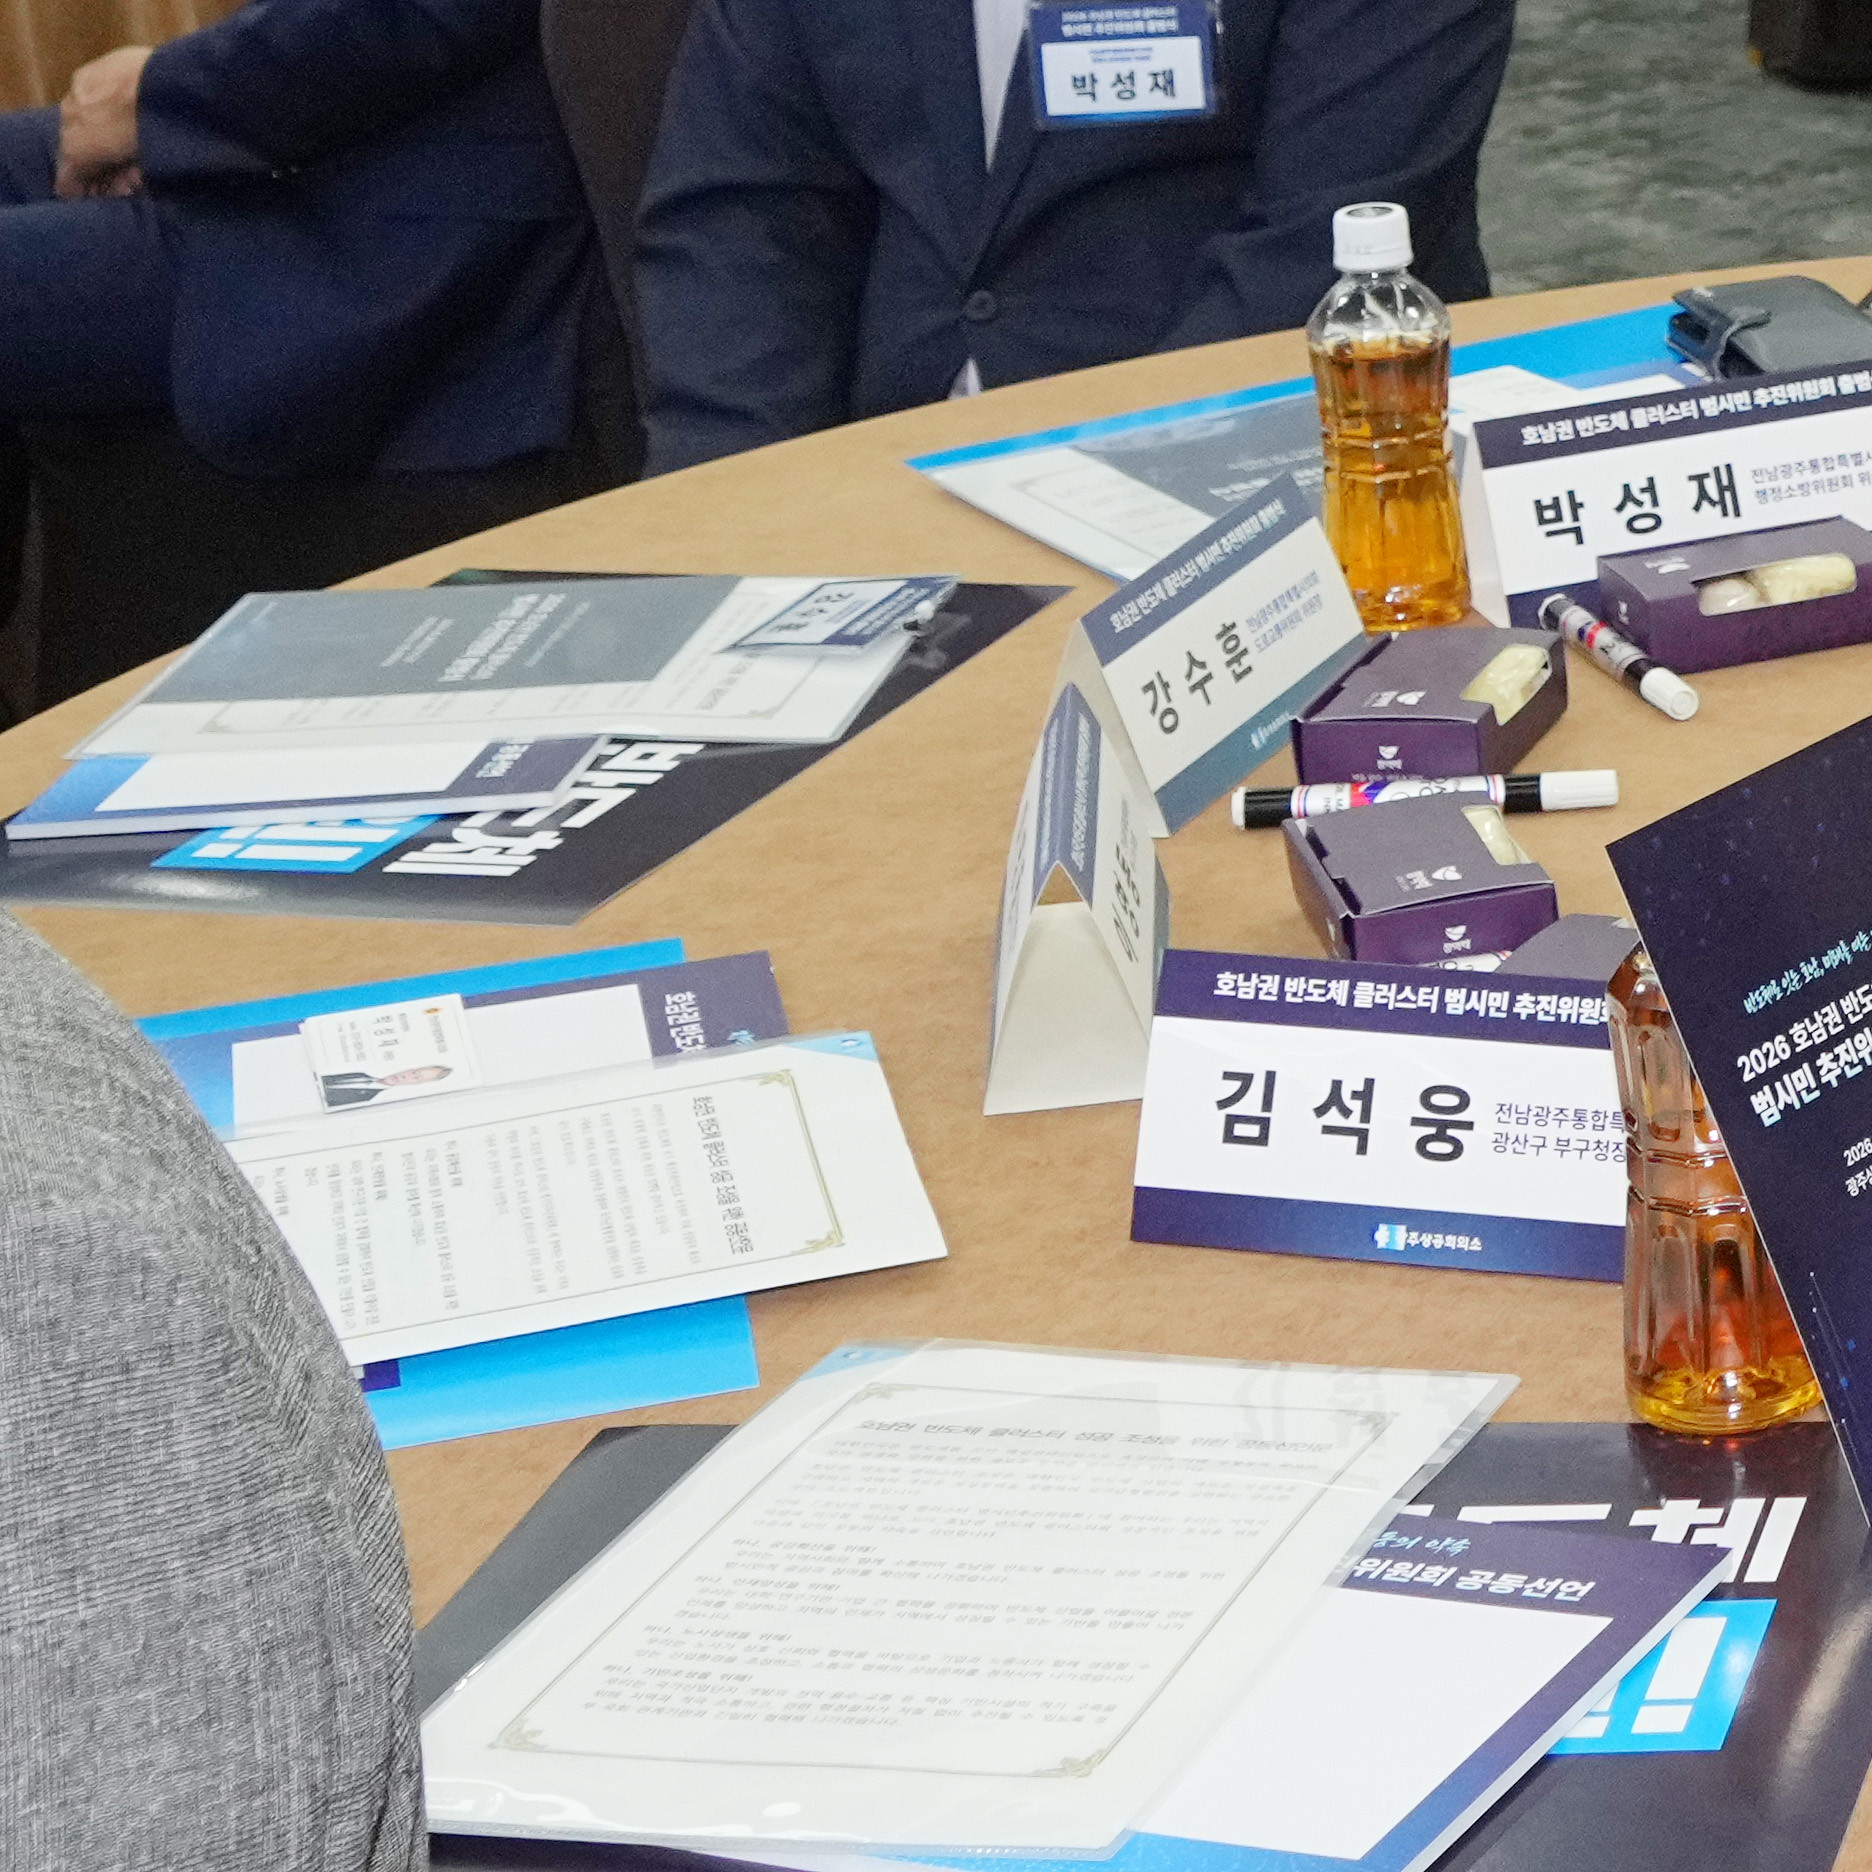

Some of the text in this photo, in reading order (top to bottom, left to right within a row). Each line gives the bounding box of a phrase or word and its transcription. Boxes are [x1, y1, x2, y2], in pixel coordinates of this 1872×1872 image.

[1072, 68, 1176, 102] 박 성 재
[1521, 424, 1574, 447] 호남권
[1575, 414, 1630, 439] 반도체
[1629, 399, 1699, 430] 클러스터
[1700, 390, 1752, 418] 범시민
[1753, 375, 1836, 411] 추진위원회
[1534, 462, 1742, 546] 박 성 재
[1142, 671, 1180, 735] 강
[1185, 650, 1214, 706] 수
[1215, 621, 1252, 683] 훈
[1214, 971, 1278, 999] 호남권
[1284, 977, 1348, 1008] 반도체
[1353, 981, 1438, 1014] 클러스터
[1444, 988, 1509, 1020] 범시민
[1736, 1034, 1792, 1082] 2026
[1789, 1001, 1846, 1053] 호남권
[1216, 1069, 1475, 1162] 김 석 웅
[1750, 1062, 1822, 1128] 범시민
[1491, 1131, 1627, 1164] 광산구 부구청장
[1351, 1558, 1596, 1602] 위원회 공동선언
